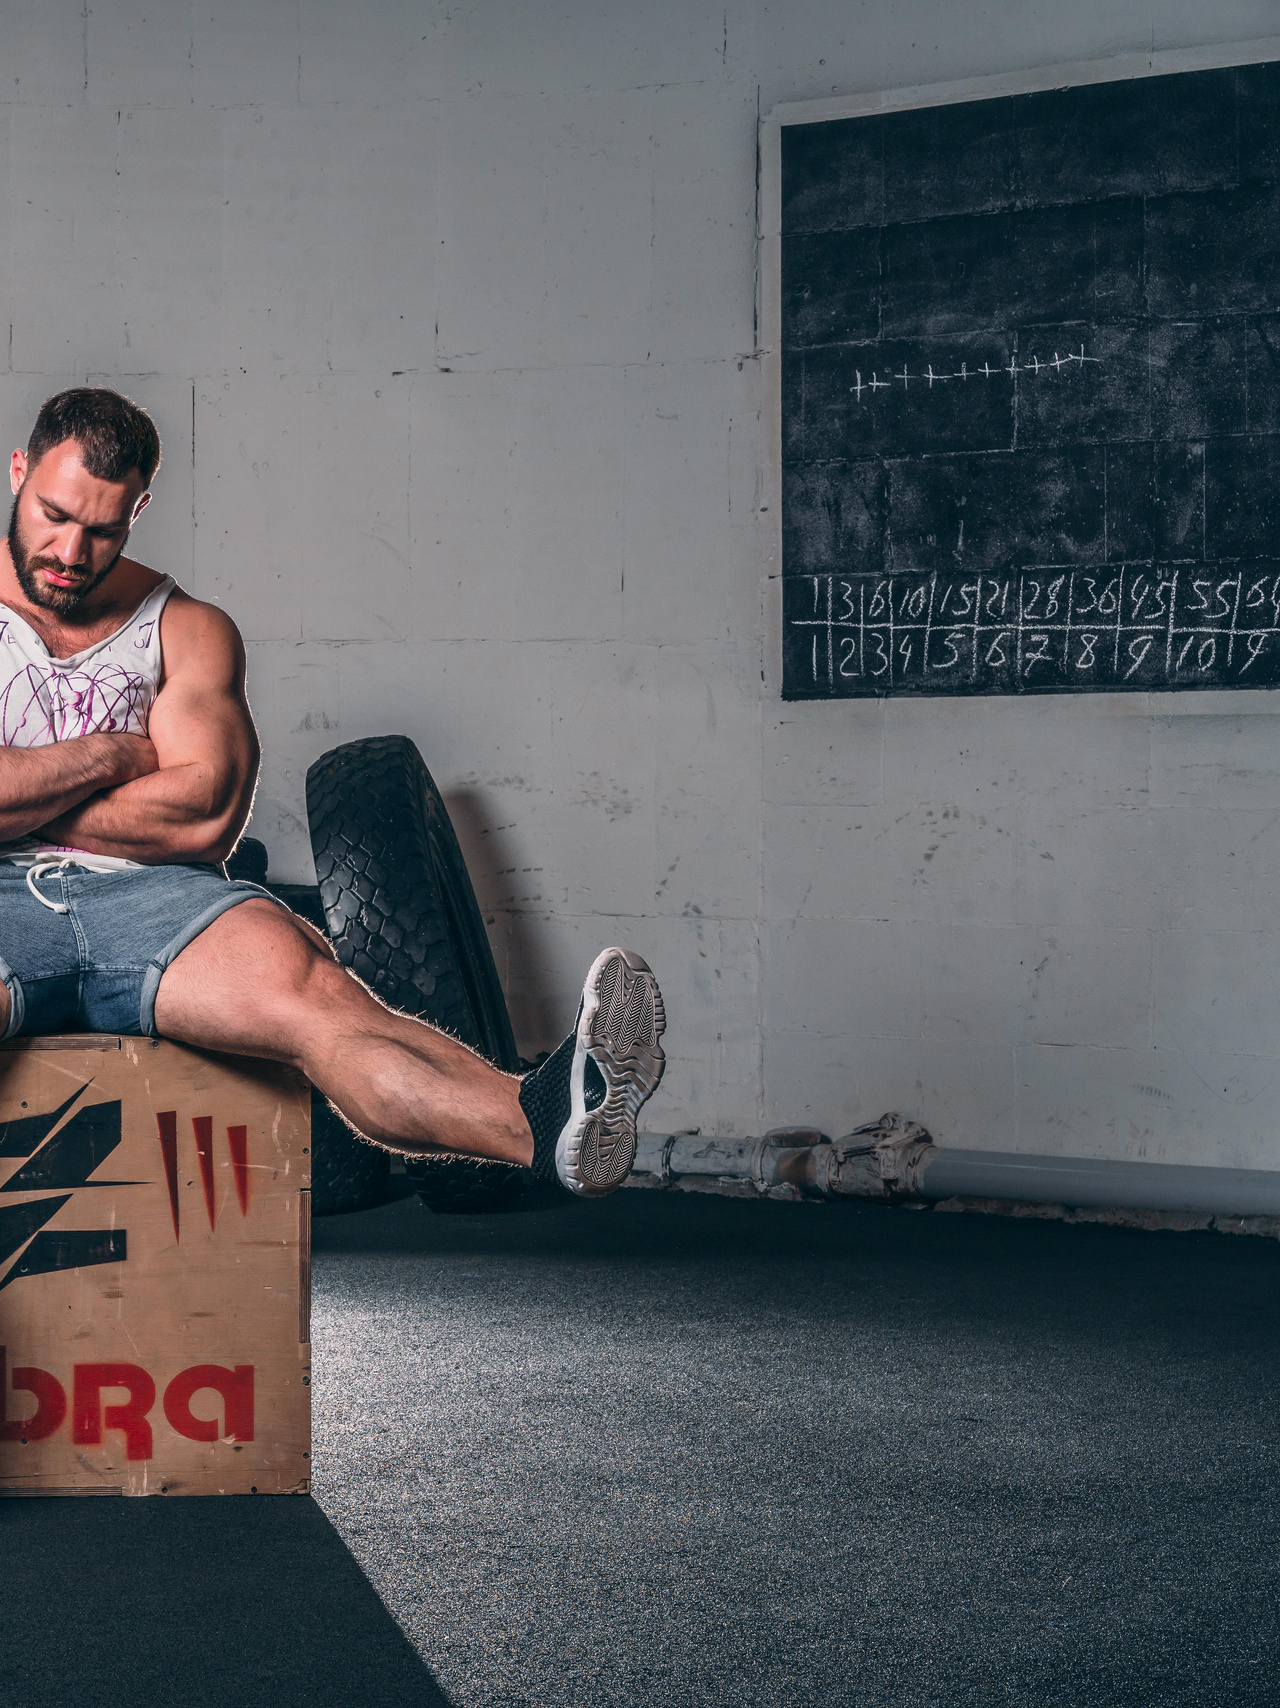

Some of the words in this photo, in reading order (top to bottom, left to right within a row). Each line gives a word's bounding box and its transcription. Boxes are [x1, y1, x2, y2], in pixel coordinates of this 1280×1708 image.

[839, 581, 854, 620] 3
[869, 580, 886, 616] 6
[899, 586, 926, 618] 10
[940, 583, 977, 616] 15
[986, 580, 1010, 620] 21
[1023, 574, 1065, 619] 28
[1076, 577, 1118, 613] 36
[1131, 574, 1171, 619] 45
[1185, 579, 1237, 618] 55
[840, 638, 860, 677] 2
[871, 633, 888, 675] 3
[899, 634, 912, 674] 4
[932, 632, 965, 668] 5
[985, 632, 1011, 667] 6
[1024, 634, 1052, 677] 7
[1076, 634, 1098, 668] 8
[1123, 635, 1154, 680] 9
[1176, 636, 1216, 671] 10
[1239, 632, 1268, 675] 9
